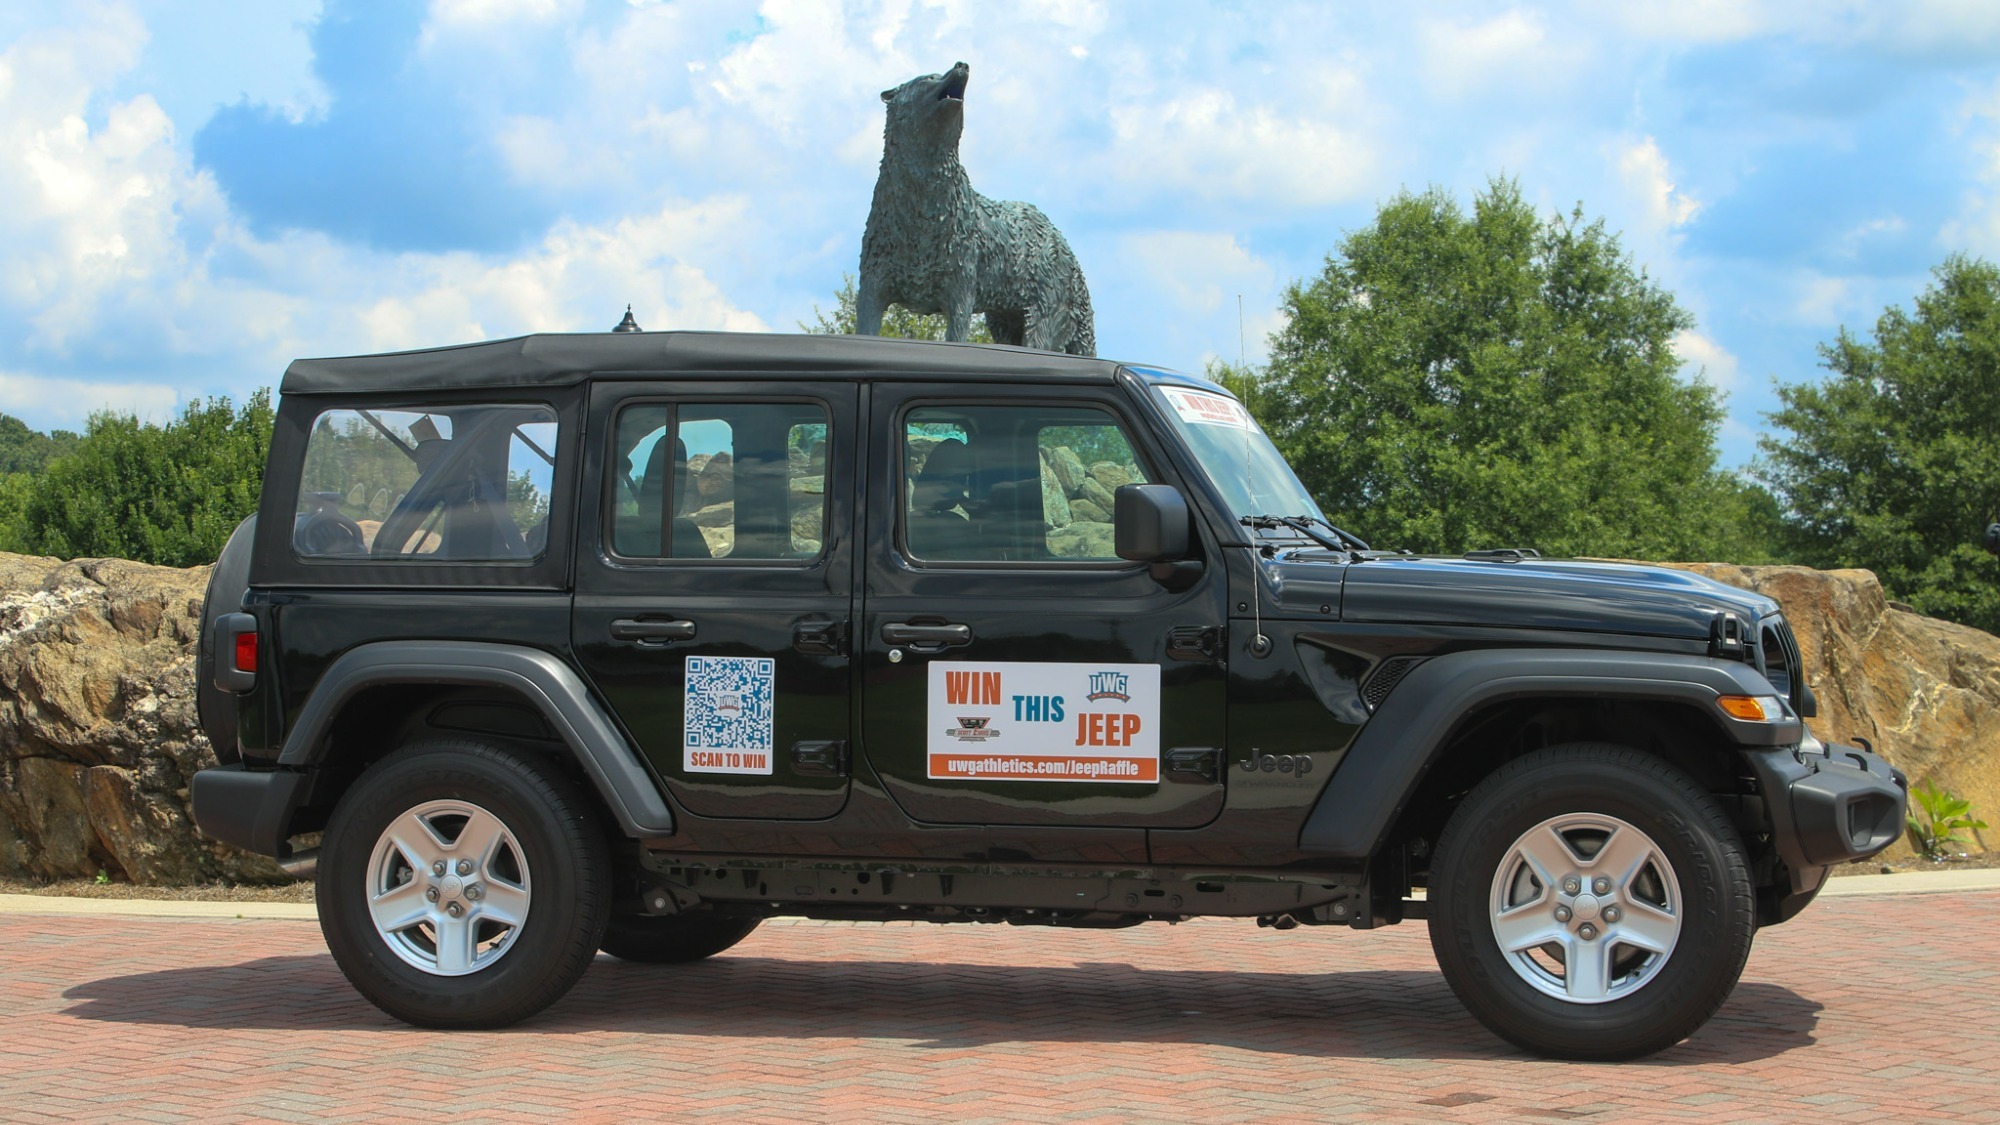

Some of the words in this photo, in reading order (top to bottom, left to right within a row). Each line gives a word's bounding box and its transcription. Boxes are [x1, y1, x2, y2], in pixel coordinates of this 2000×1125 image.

[945, 671, 1001, 705] WIN
[1089, 672, 1128, 694] UWG
[1012, 695, 1065, 722] THIS
[1075, 713, 1142, 747] JEEP
[691, 751, 723, 767] SCAN
[726, 753, 740, 767] TO
[743, 754, 766, 768] WIN
[948, 758, 1139, 778] uwgathletics.com/JeepRaffle
[1240, 747, 1313, 778] Jeep
